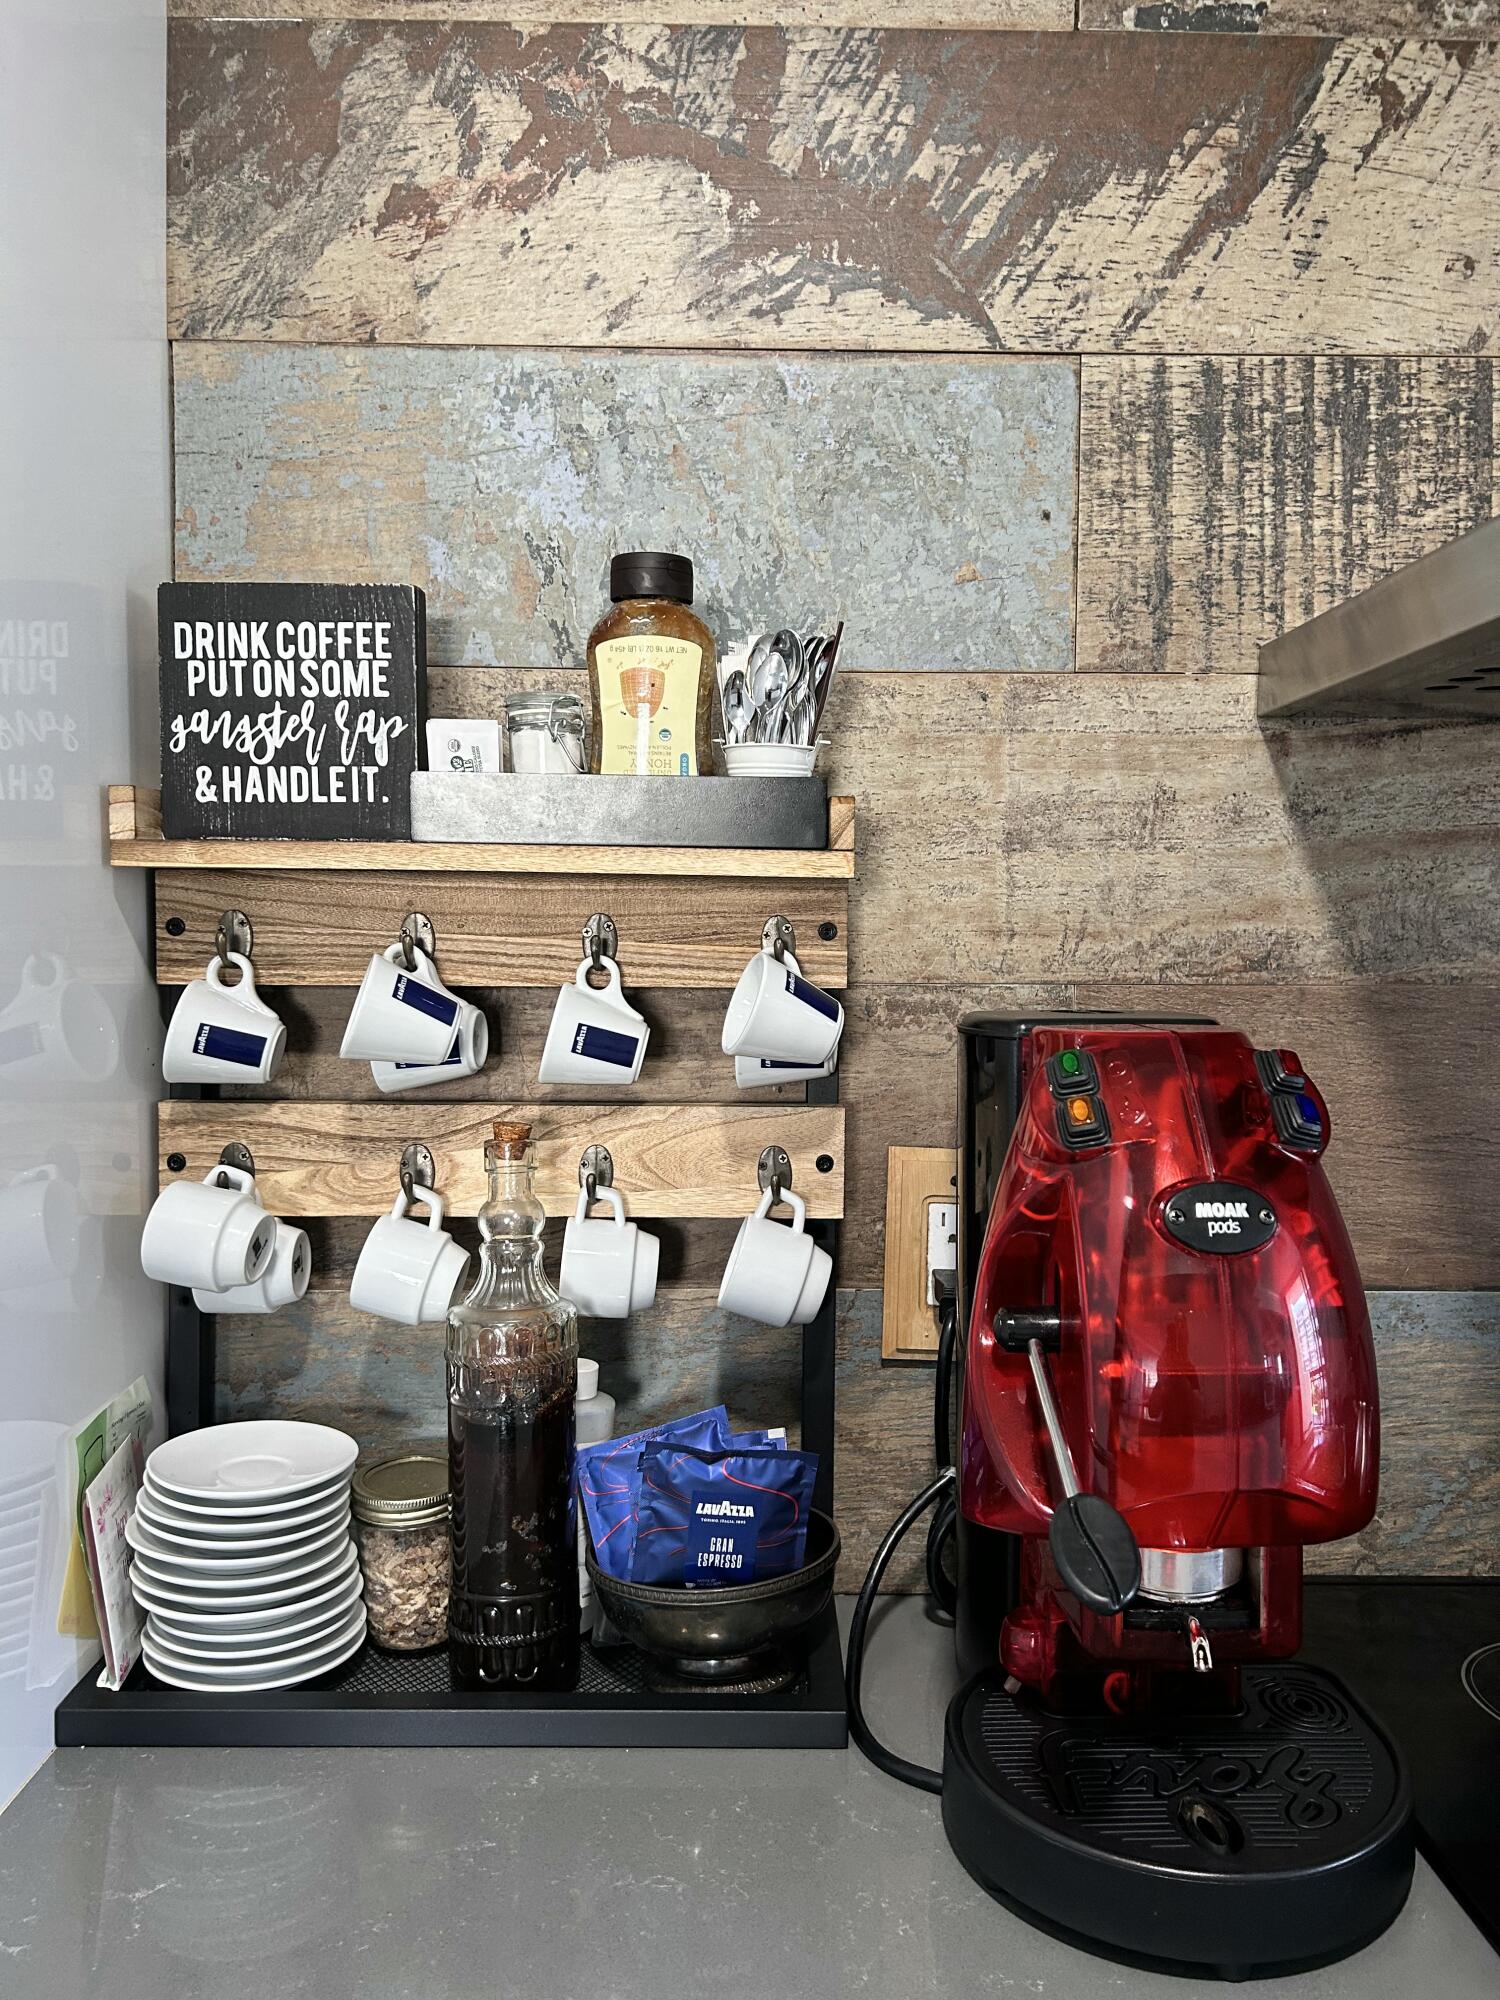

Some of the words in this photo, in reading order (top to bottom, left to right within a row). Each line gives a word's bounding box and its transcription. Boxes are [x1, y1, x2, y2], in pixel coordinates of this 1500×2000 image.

[173, 621, 271, 660] DRINK
[276, 621, 393, 660] COFFEE
[614, 645, 626, 653] 454
[646, 645, 654, 653] OZ
[655, 645, 663, 653] 16
[665, 645, 675, 653] WT
[675, 646, 688, 654] NET
[187, 659, 247, 698] PUT
[253, 659, 296, 698] ON
[300, 659, 391, 698] SOME
[169, 699, 327, 766] gangster
[334, 699, 408, 767] rap
[630, 758, 673, 769] HONY
[195, 765, 218, 803] &
[222, 765, 347, 803] HANDLE
[351, 766, 390, 803] IT.
[396, 975, 408, 1000] LAVAZZA
[197, 1025, 211, 1054] LAVAZZA
[576, 1025, 588, 1054] LAVAZZA
[1195, 1202, 1250, 1219] MOAK
[1207, 1219, 1242, 1237] pods
[695, 1500, 755, 1518] LAVAZZA
[710, 1537, 734, 1553] GRAN
[697, 1553, 743, 1569] ESPRESSO
